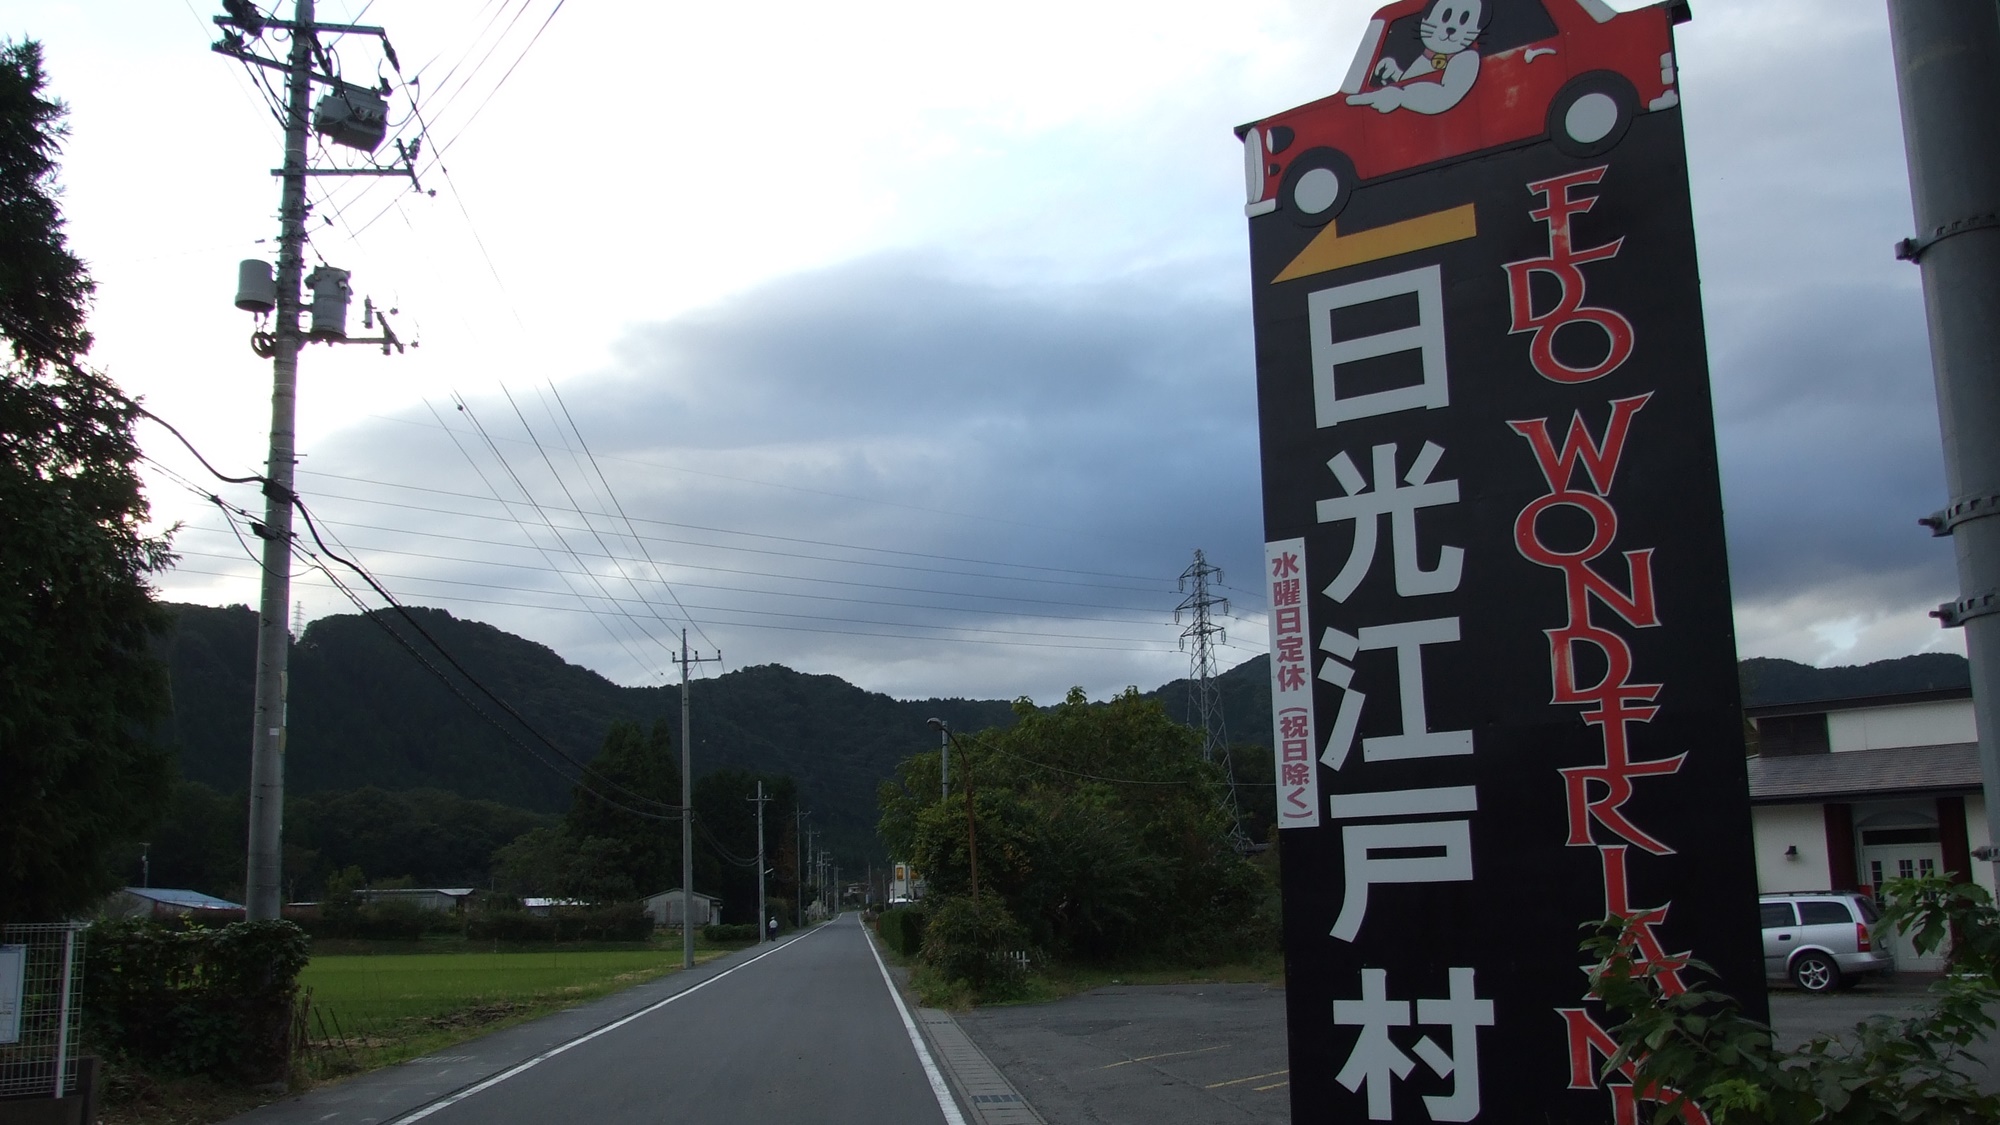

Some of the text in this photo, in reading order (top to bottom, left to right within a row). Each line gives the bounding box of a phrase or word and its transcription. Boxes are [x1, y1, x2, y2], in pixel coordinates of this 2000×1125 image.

[1501, 164, 1634, 384] EDO
[1307, 264, 1496, 1123] 日光江戸村
